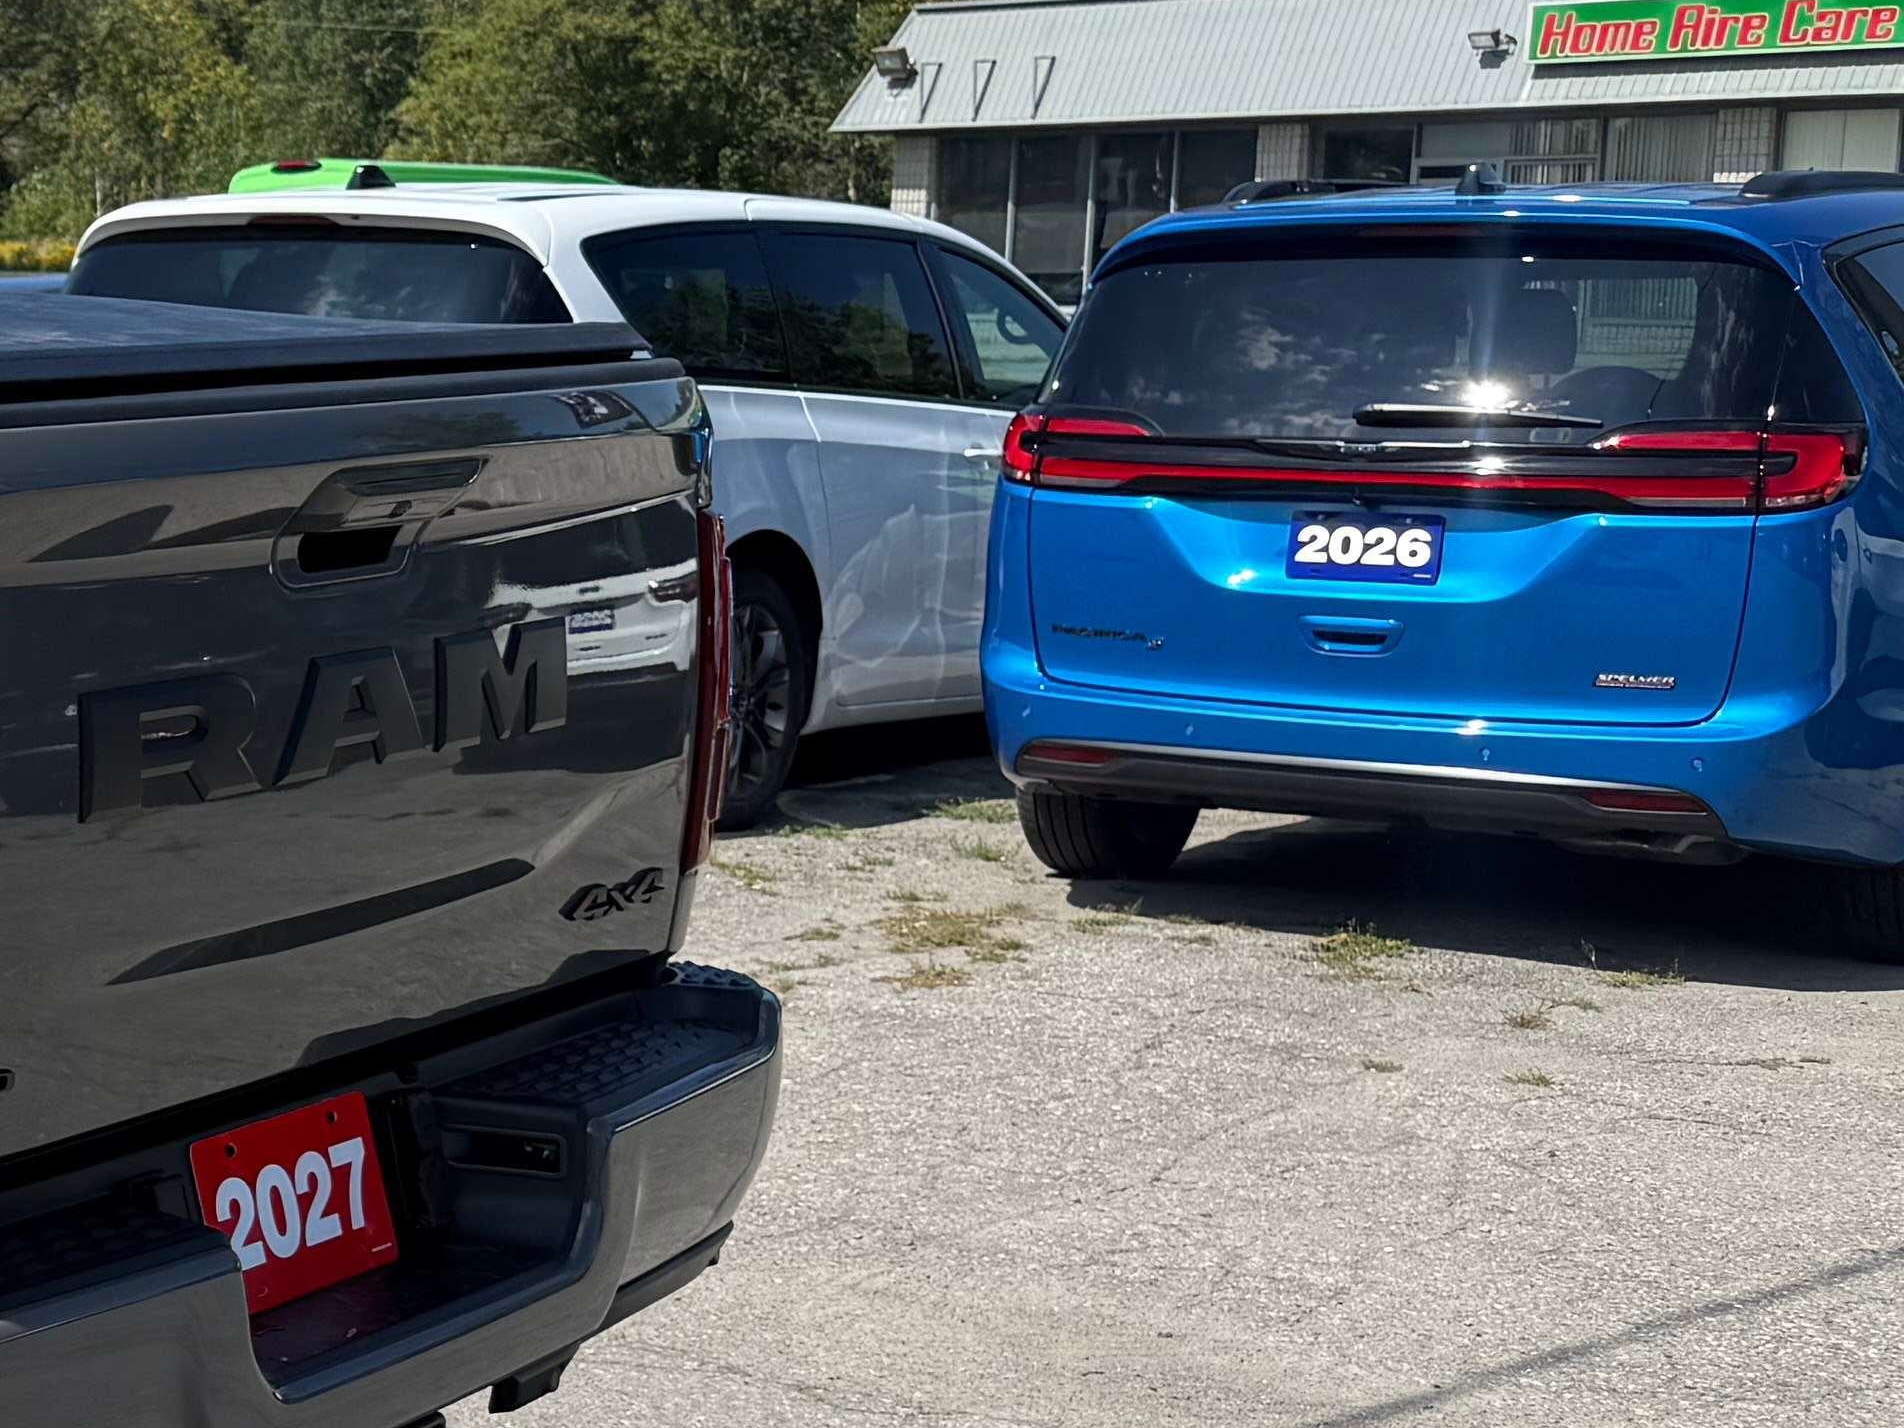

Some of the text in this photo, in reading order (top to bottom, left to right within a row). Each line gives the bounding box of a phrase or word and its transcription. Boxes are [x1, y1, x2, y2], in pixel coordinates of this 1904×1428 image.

[1537, 10, 1660, 58] Home
[1667, 3, 1769, 51] Aire
[1294, 524, 1432, 568] 2026
[77, 616, 568, 824] RAM
[215, 1136, 366, 1272] 2027
